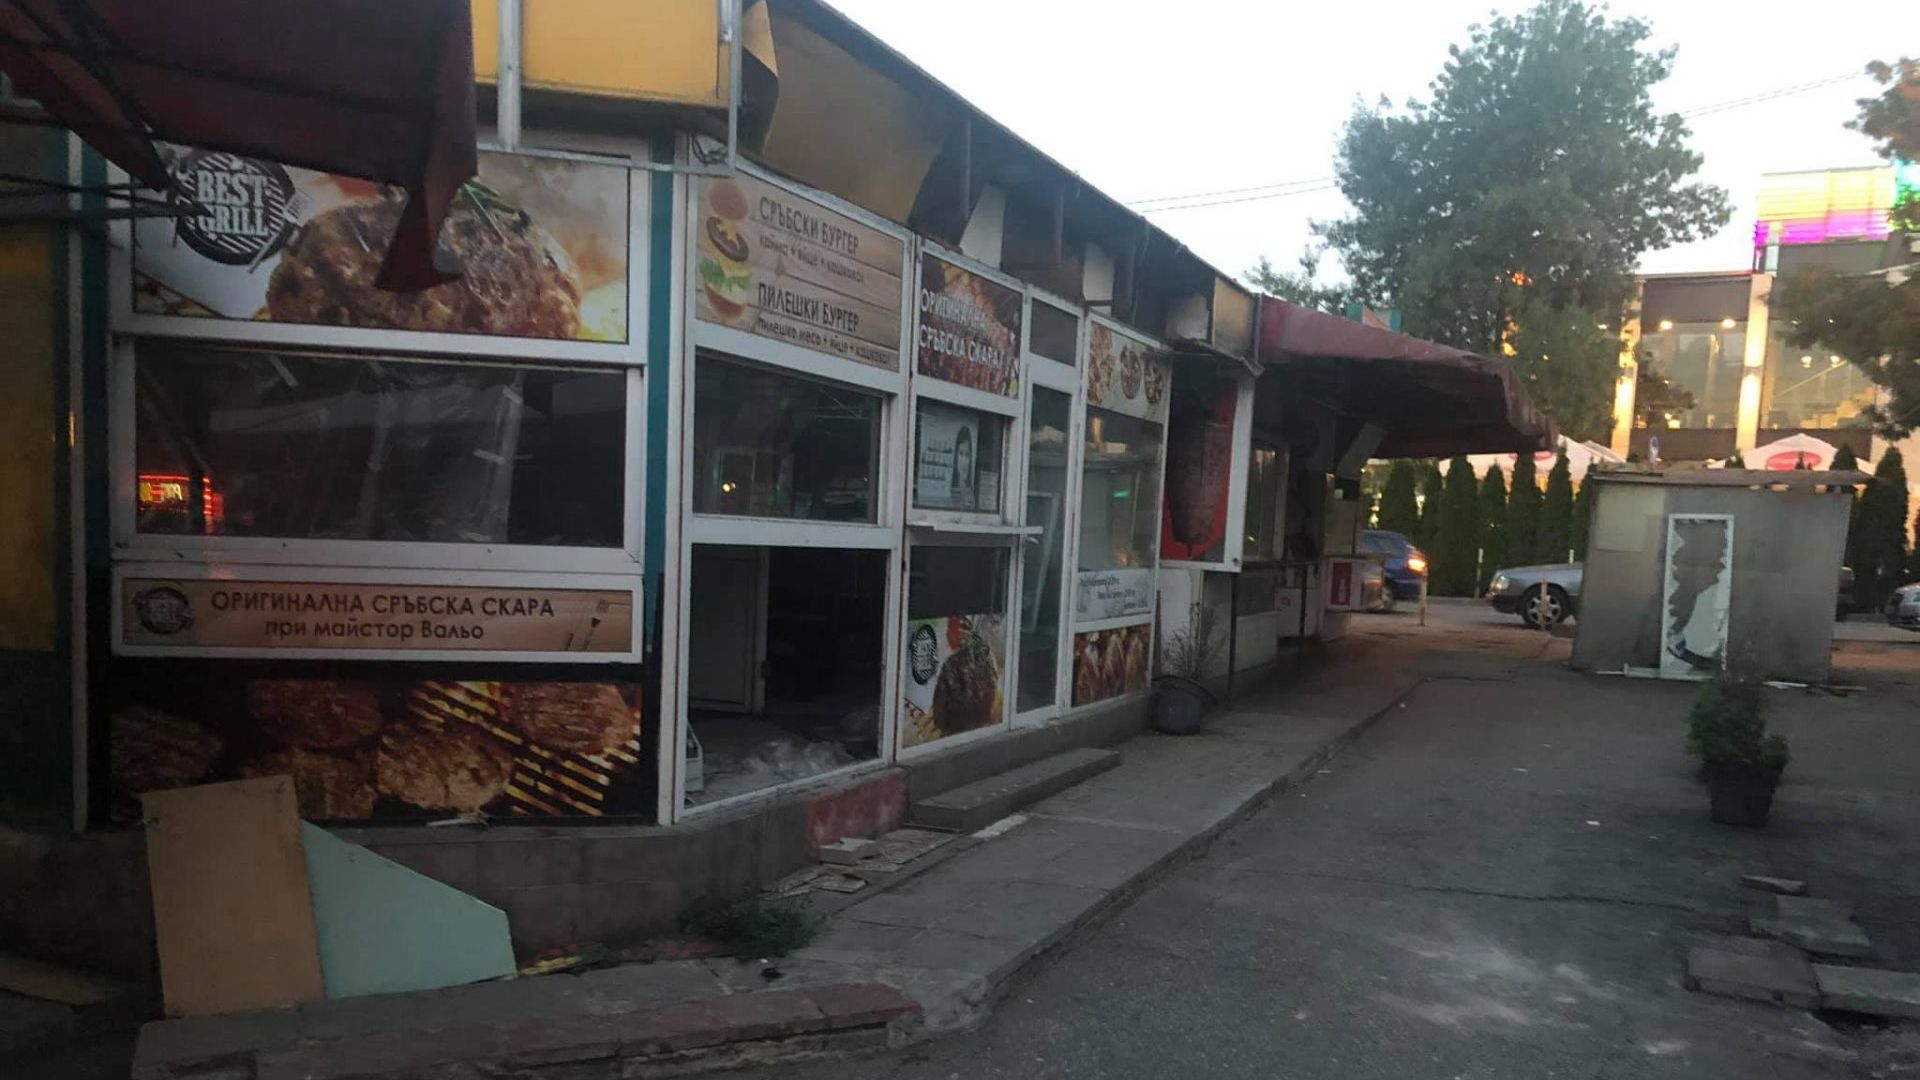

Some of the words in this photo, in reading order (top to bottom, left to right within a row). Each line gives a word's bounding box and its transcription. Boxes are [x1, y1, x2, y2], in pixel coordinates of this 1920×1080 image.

[196, 169, 267, 207] BEST
[197, 202, 268, 236] GRILL
[759, 196, 819, 239] СРЪБСКИ
[822, 221, 859, 255] БУРГЕР
[758, 282, 819, 320] ПИЛЕШКИ
[822, 302, 859, 333] БУРГЕР
[920, 323, 965, 357] СРЪБСКА
[967, 340, 998, 369] СКАРА
[211, 590, 364, 613] ОРИГИНАЛНА
[373, 594, 474, 615] СРЪБСКА
[482, 597, 554, 617] СКАРА
[265, 621, 306, 639] при
[314, 617, 414, 641] майстор
[421, 620, 484, 639] Вальо
